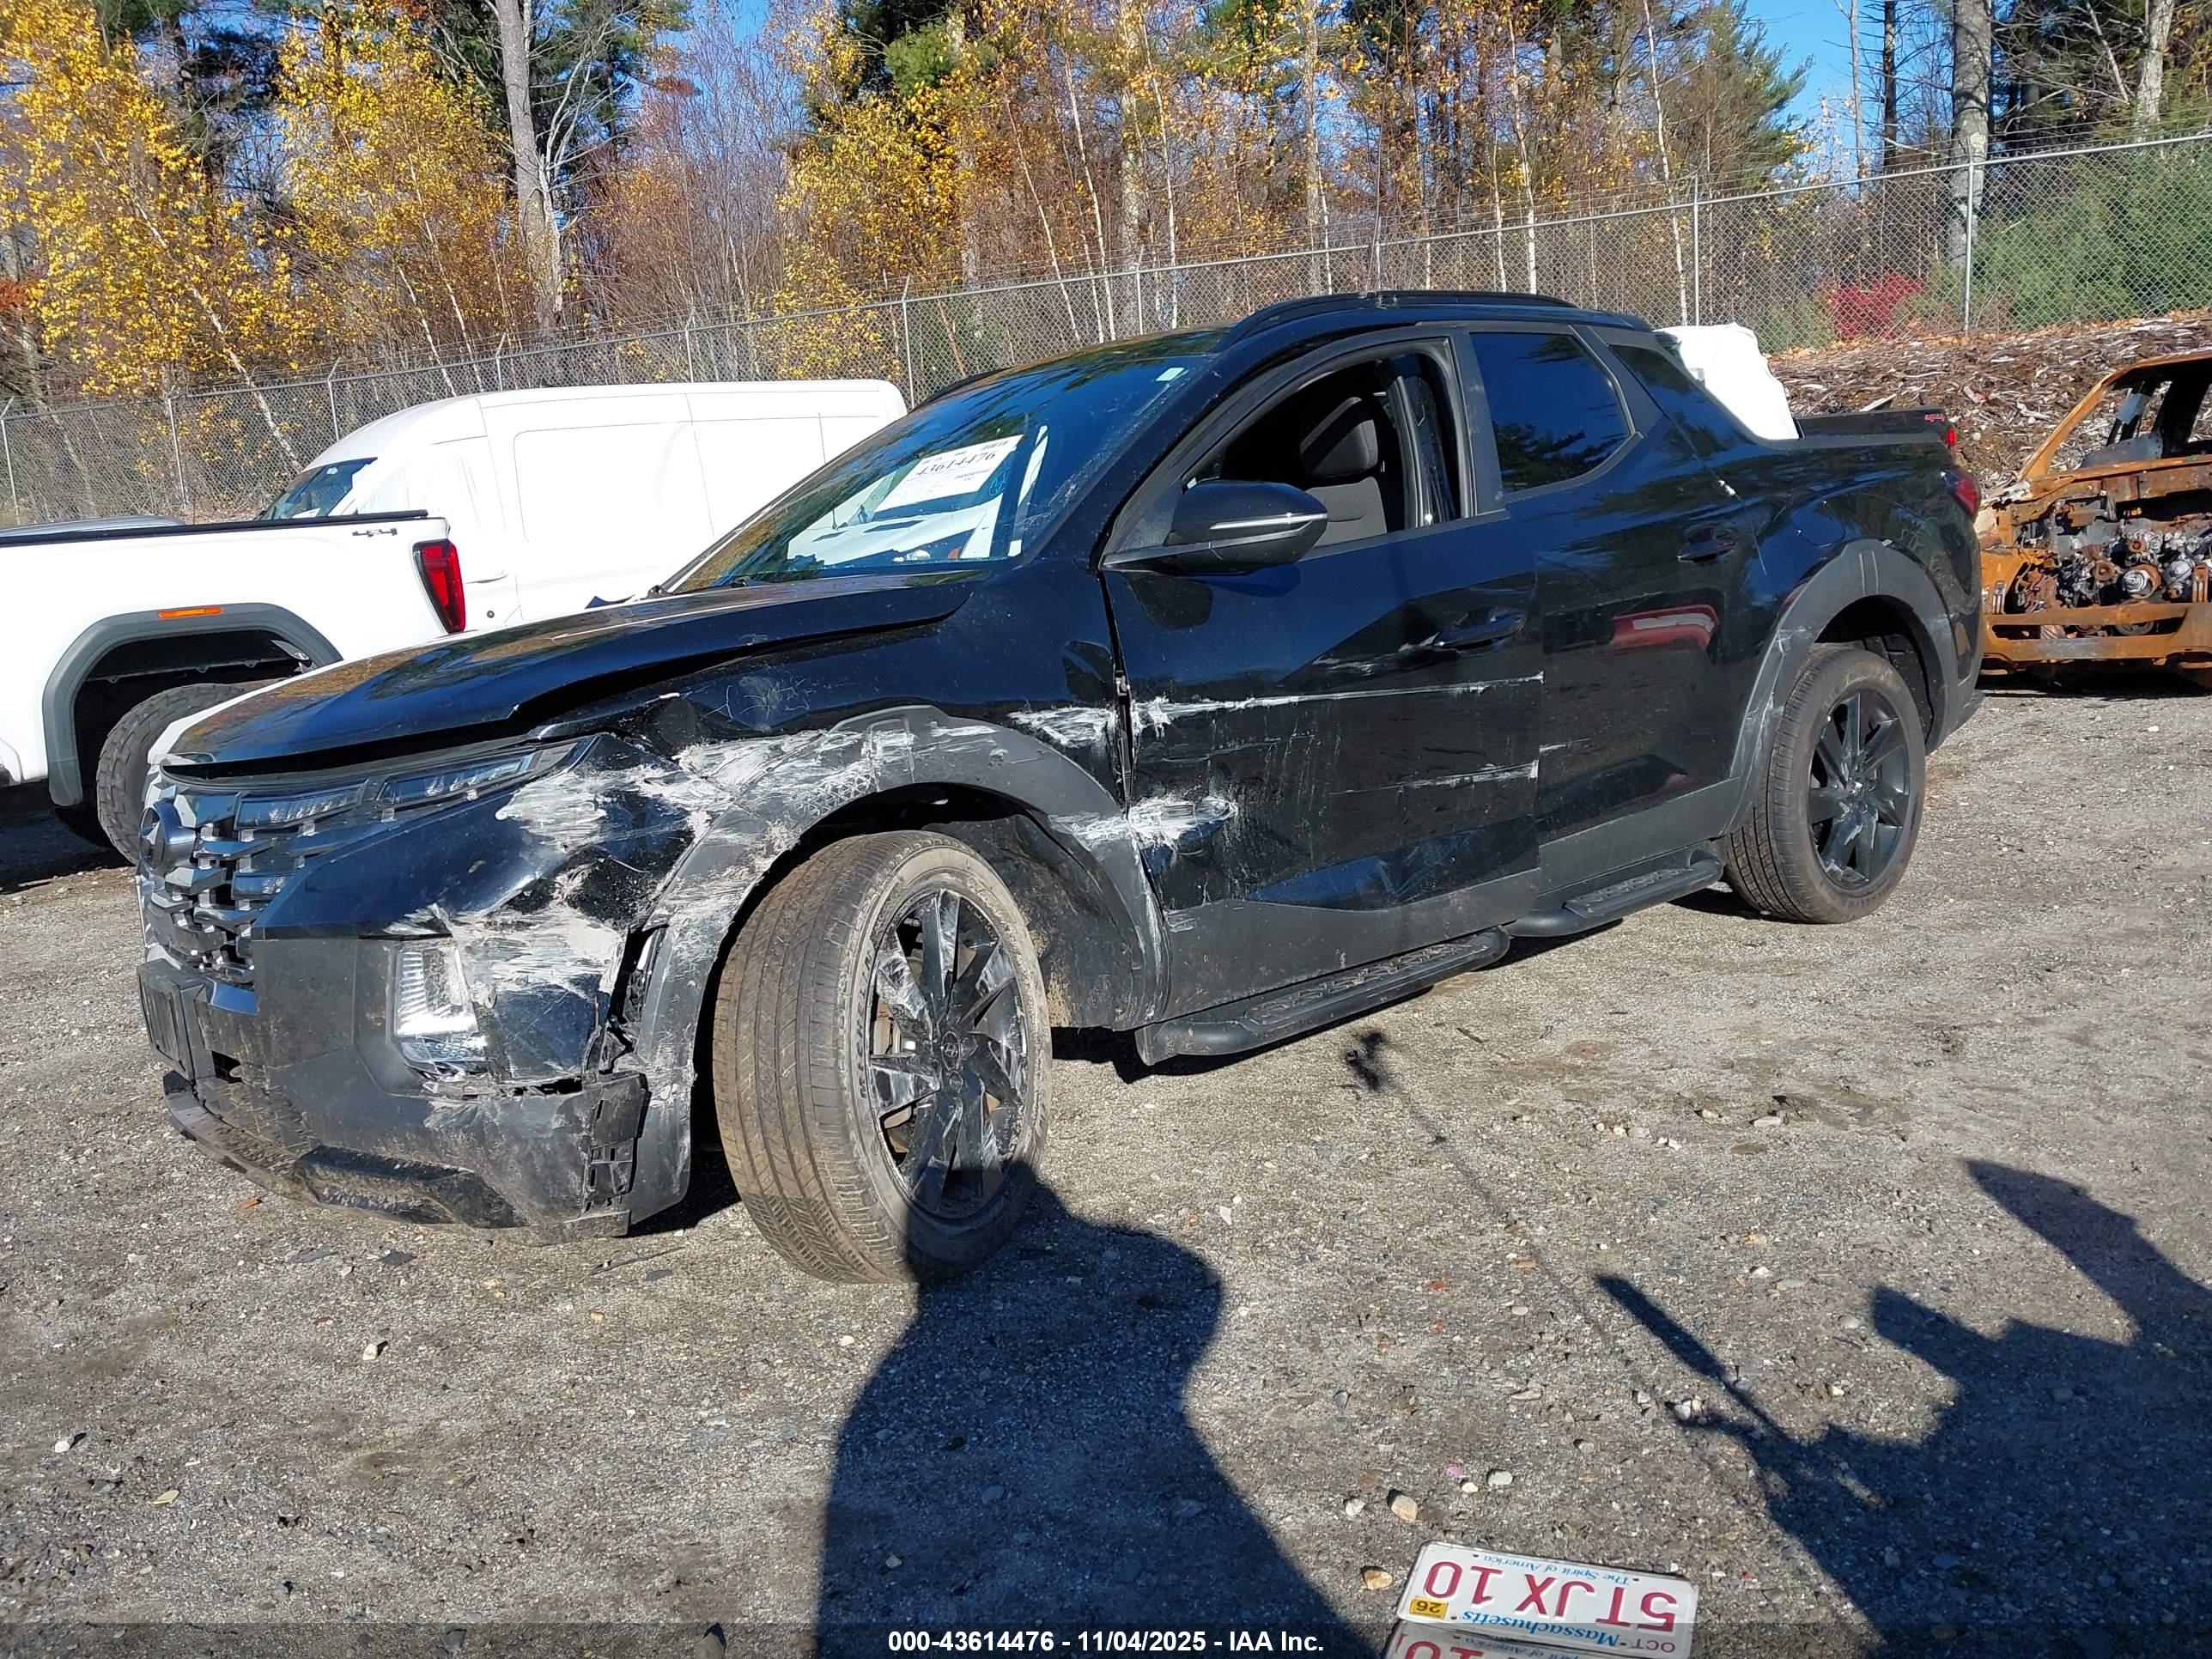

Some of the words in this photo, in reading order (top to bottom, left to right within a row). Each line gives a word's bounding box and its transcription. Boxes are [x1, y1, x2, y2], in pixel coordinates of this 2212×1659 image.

[1483, 1554, 1542, 1572] America
[1546, 1565, 1559, 1573] of
[1562, 1567, 1600, 1581] Spirit
[1602, 1575, 1629, 1585] The
[1415, 1600, 1443, 1614] 26
[1462, 1610, 1620, 1648] Massachusetts
[1631, 1638, 1676, 1654] OCT
